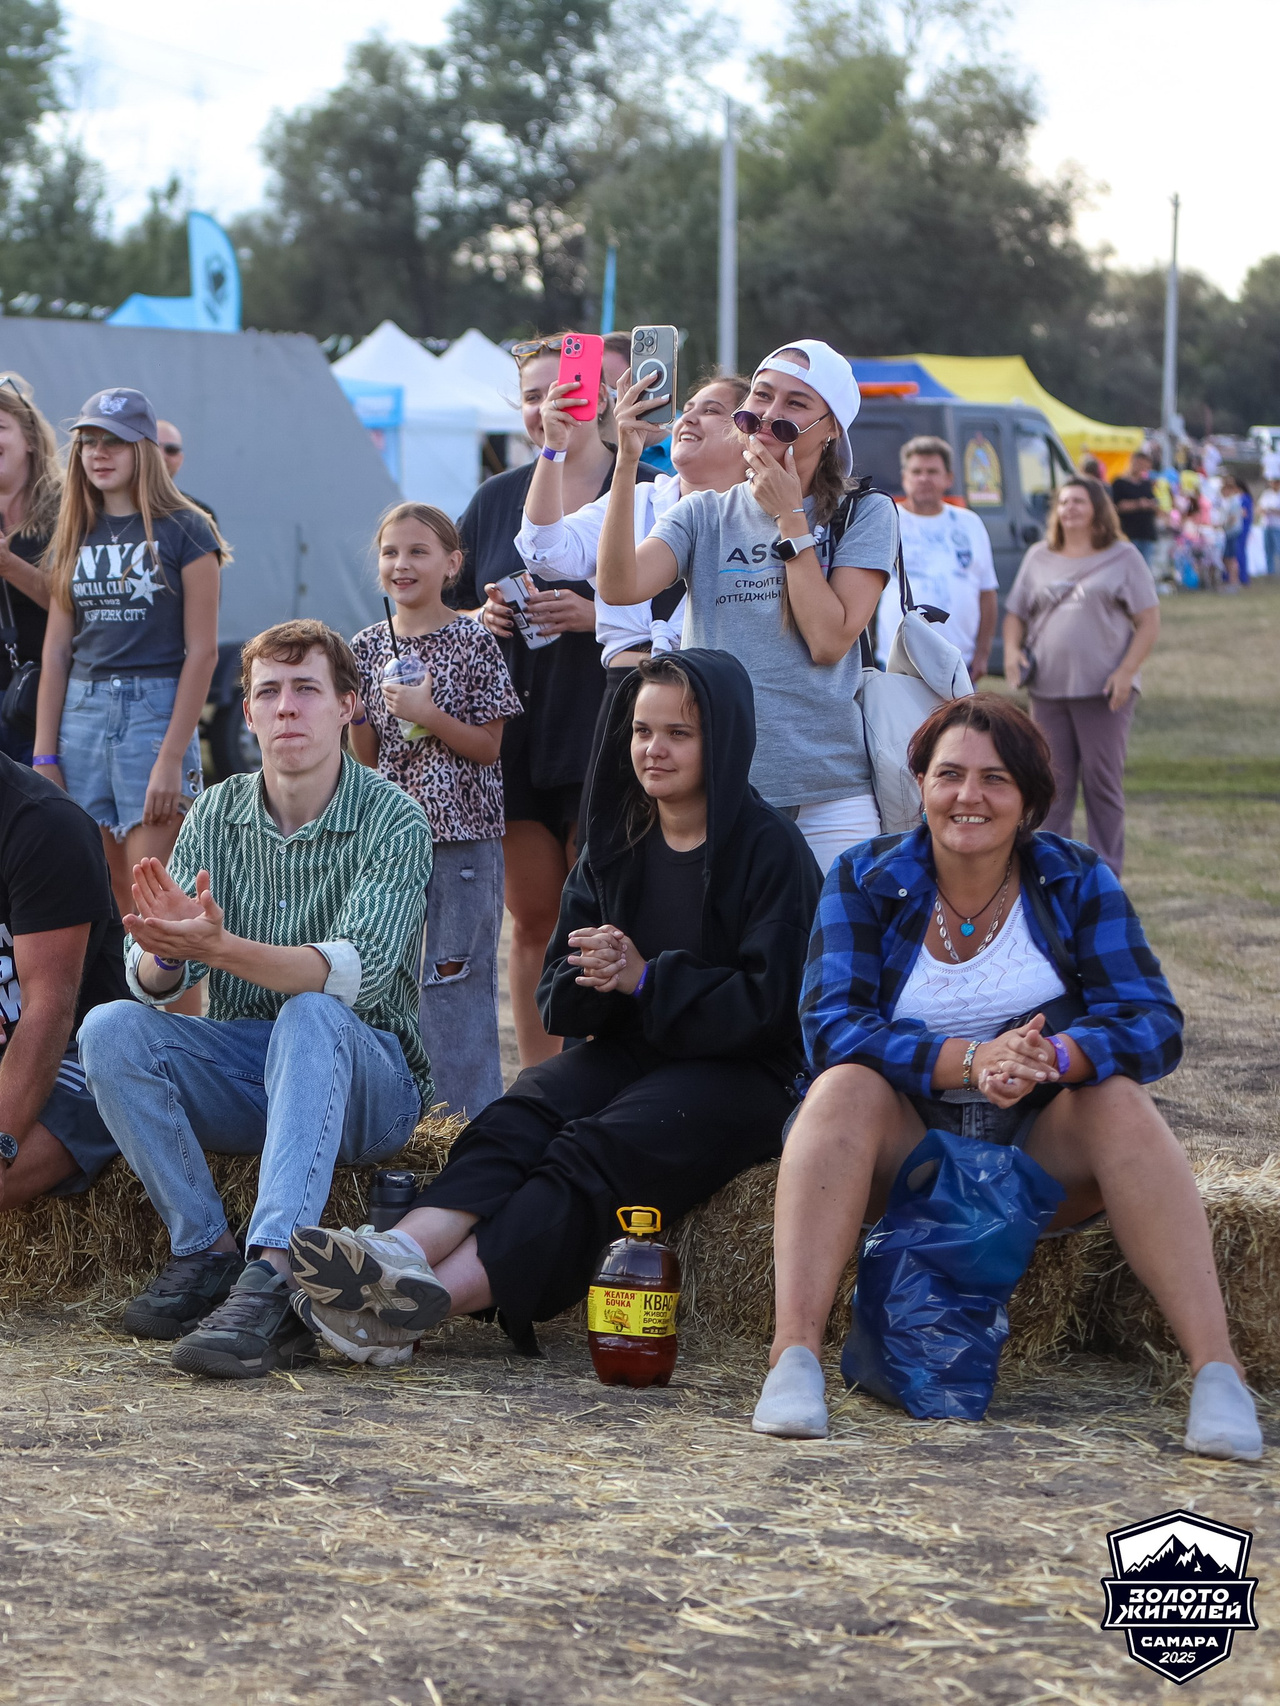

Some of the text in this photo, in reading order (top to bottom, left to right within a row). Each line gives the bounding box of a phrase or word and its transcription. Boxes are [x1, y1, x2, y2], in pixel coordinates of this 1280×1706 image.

[72, 540, 160, 581] NYC
[73, 579, 133, 597] SOCIAL CLUB
[123, 607, 147, 622] CITY
[604, 1290, 635, 1300] ЖЕЛТАЯ
[606, 1298, 631, 1308] БОЧКА
[644, 1294, 674, 1312] КВАС
